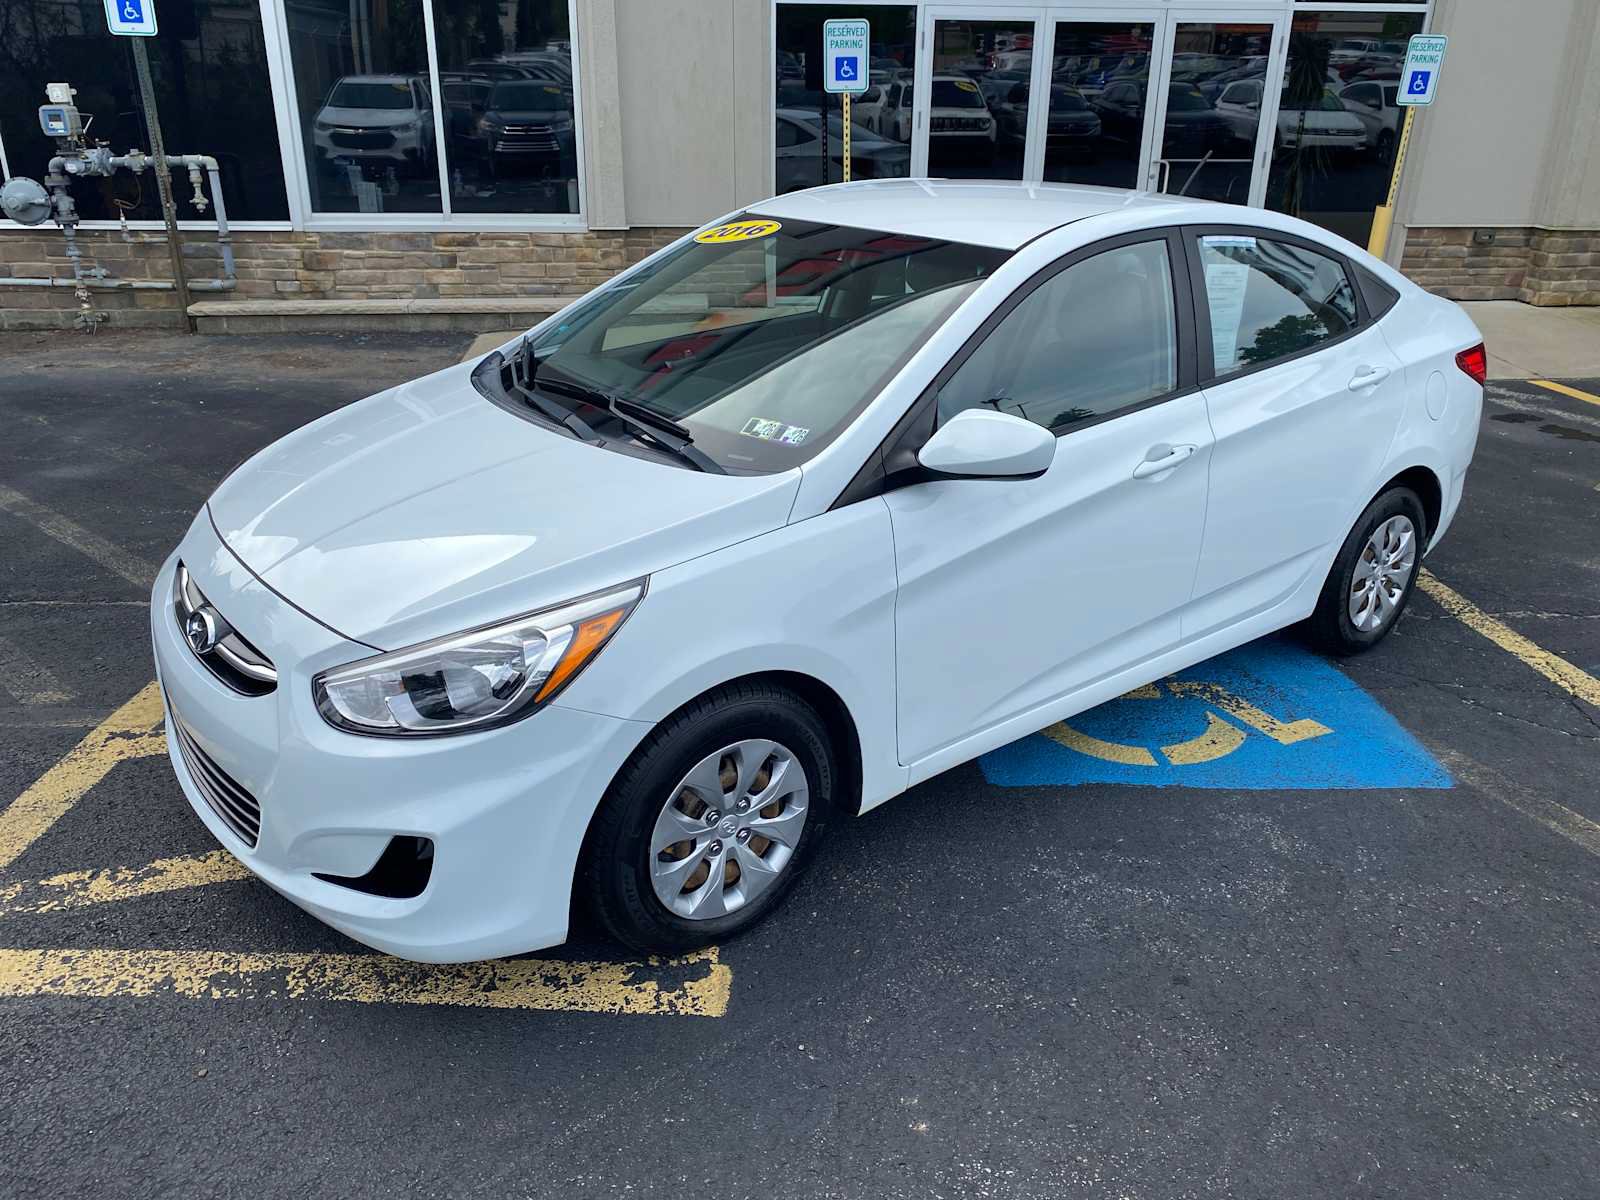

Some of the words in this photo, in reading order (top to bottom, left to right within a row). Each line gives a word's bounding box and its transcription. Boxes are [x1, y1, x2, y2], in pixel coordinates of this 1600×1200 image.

[827, 27, 866, 36] RESERVED
[830, 40, 863, 49] PARKING
[1409, 42, 1443, 51] RESERVED
[1411, 54, 1439, 63] PARKING
[702, 223, 774, 239] 2016
